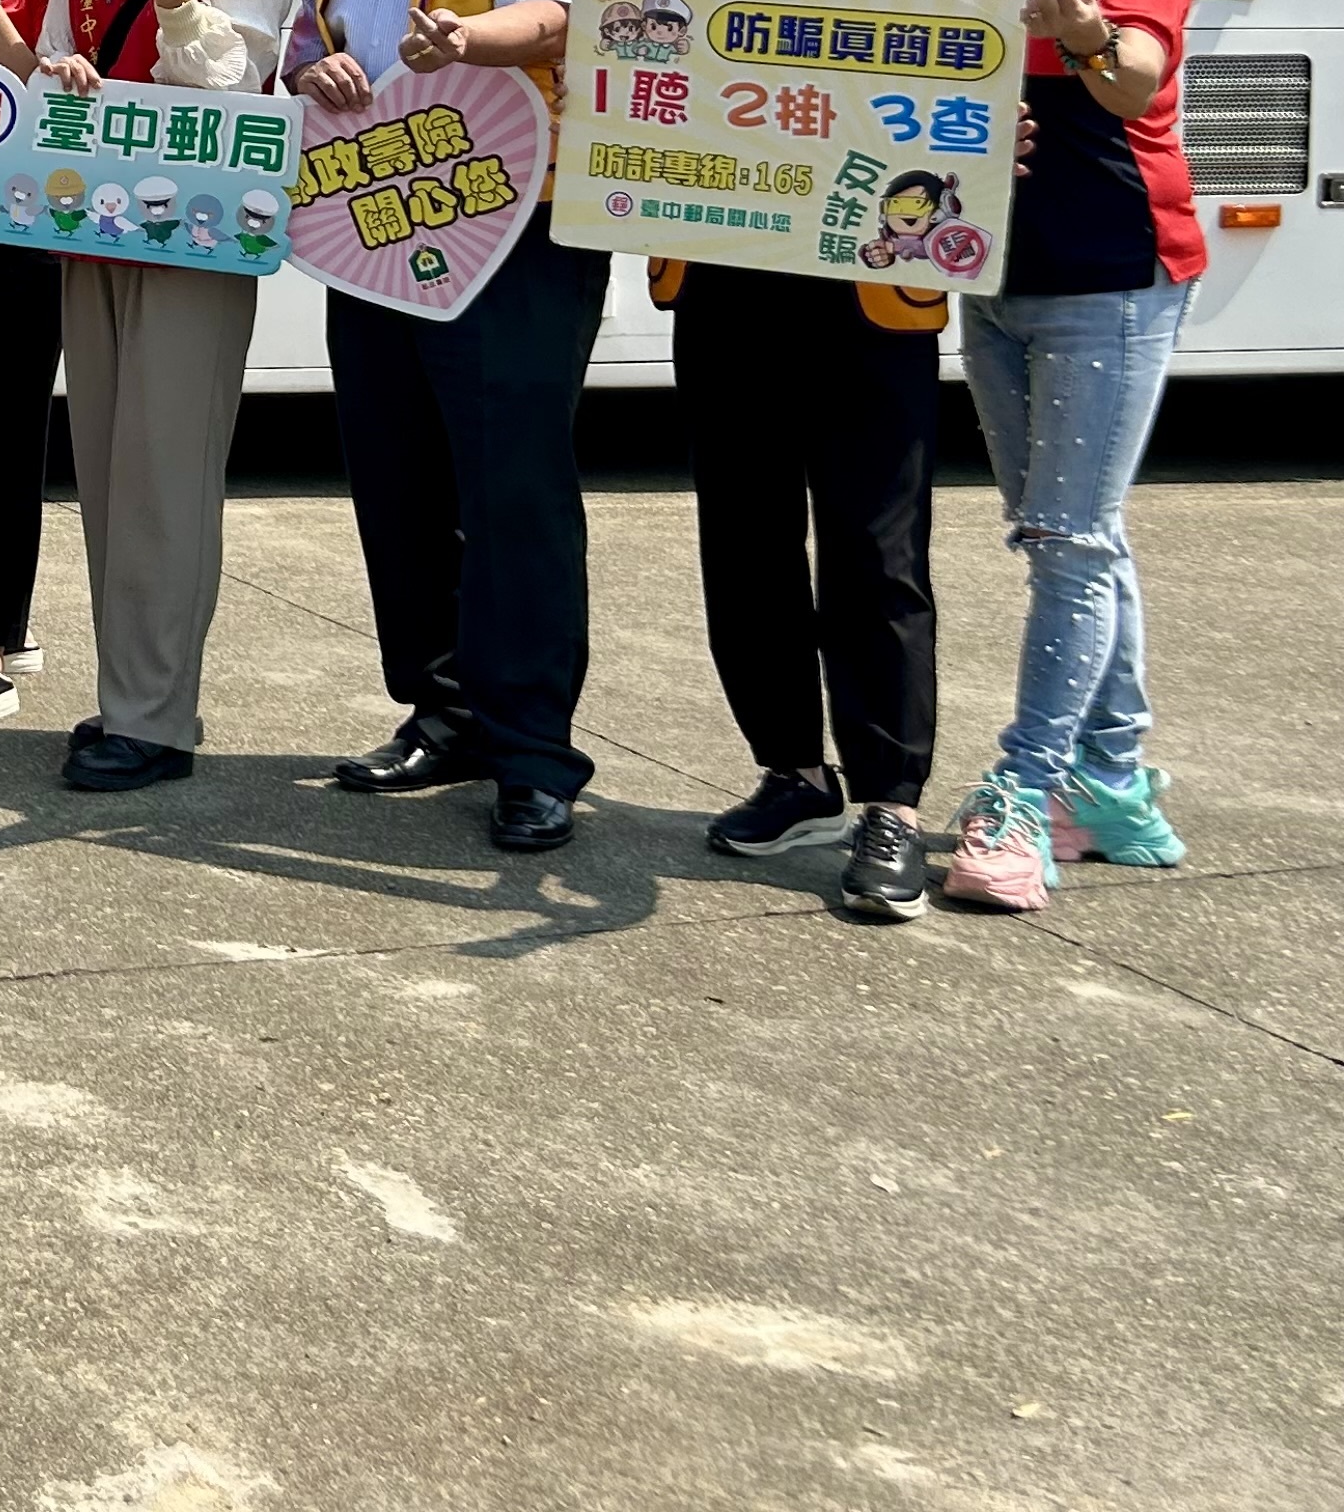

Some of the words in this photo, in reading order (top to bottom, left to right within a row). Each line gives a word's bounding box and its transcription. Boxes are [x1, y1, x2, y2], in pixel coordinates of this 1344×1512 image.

[36, 91, 288, 173] 臺中郵局
[594, 67, 691, 126] 1聽
[720, 81, 838, 140] 2掛
[870, 94, 990, 154] 3查
[348, 154, 519, 252] 關心您
[639, 197, 792, 233] 臺中郵局關心您
[818, 148, 889, 265] 反詐騙
